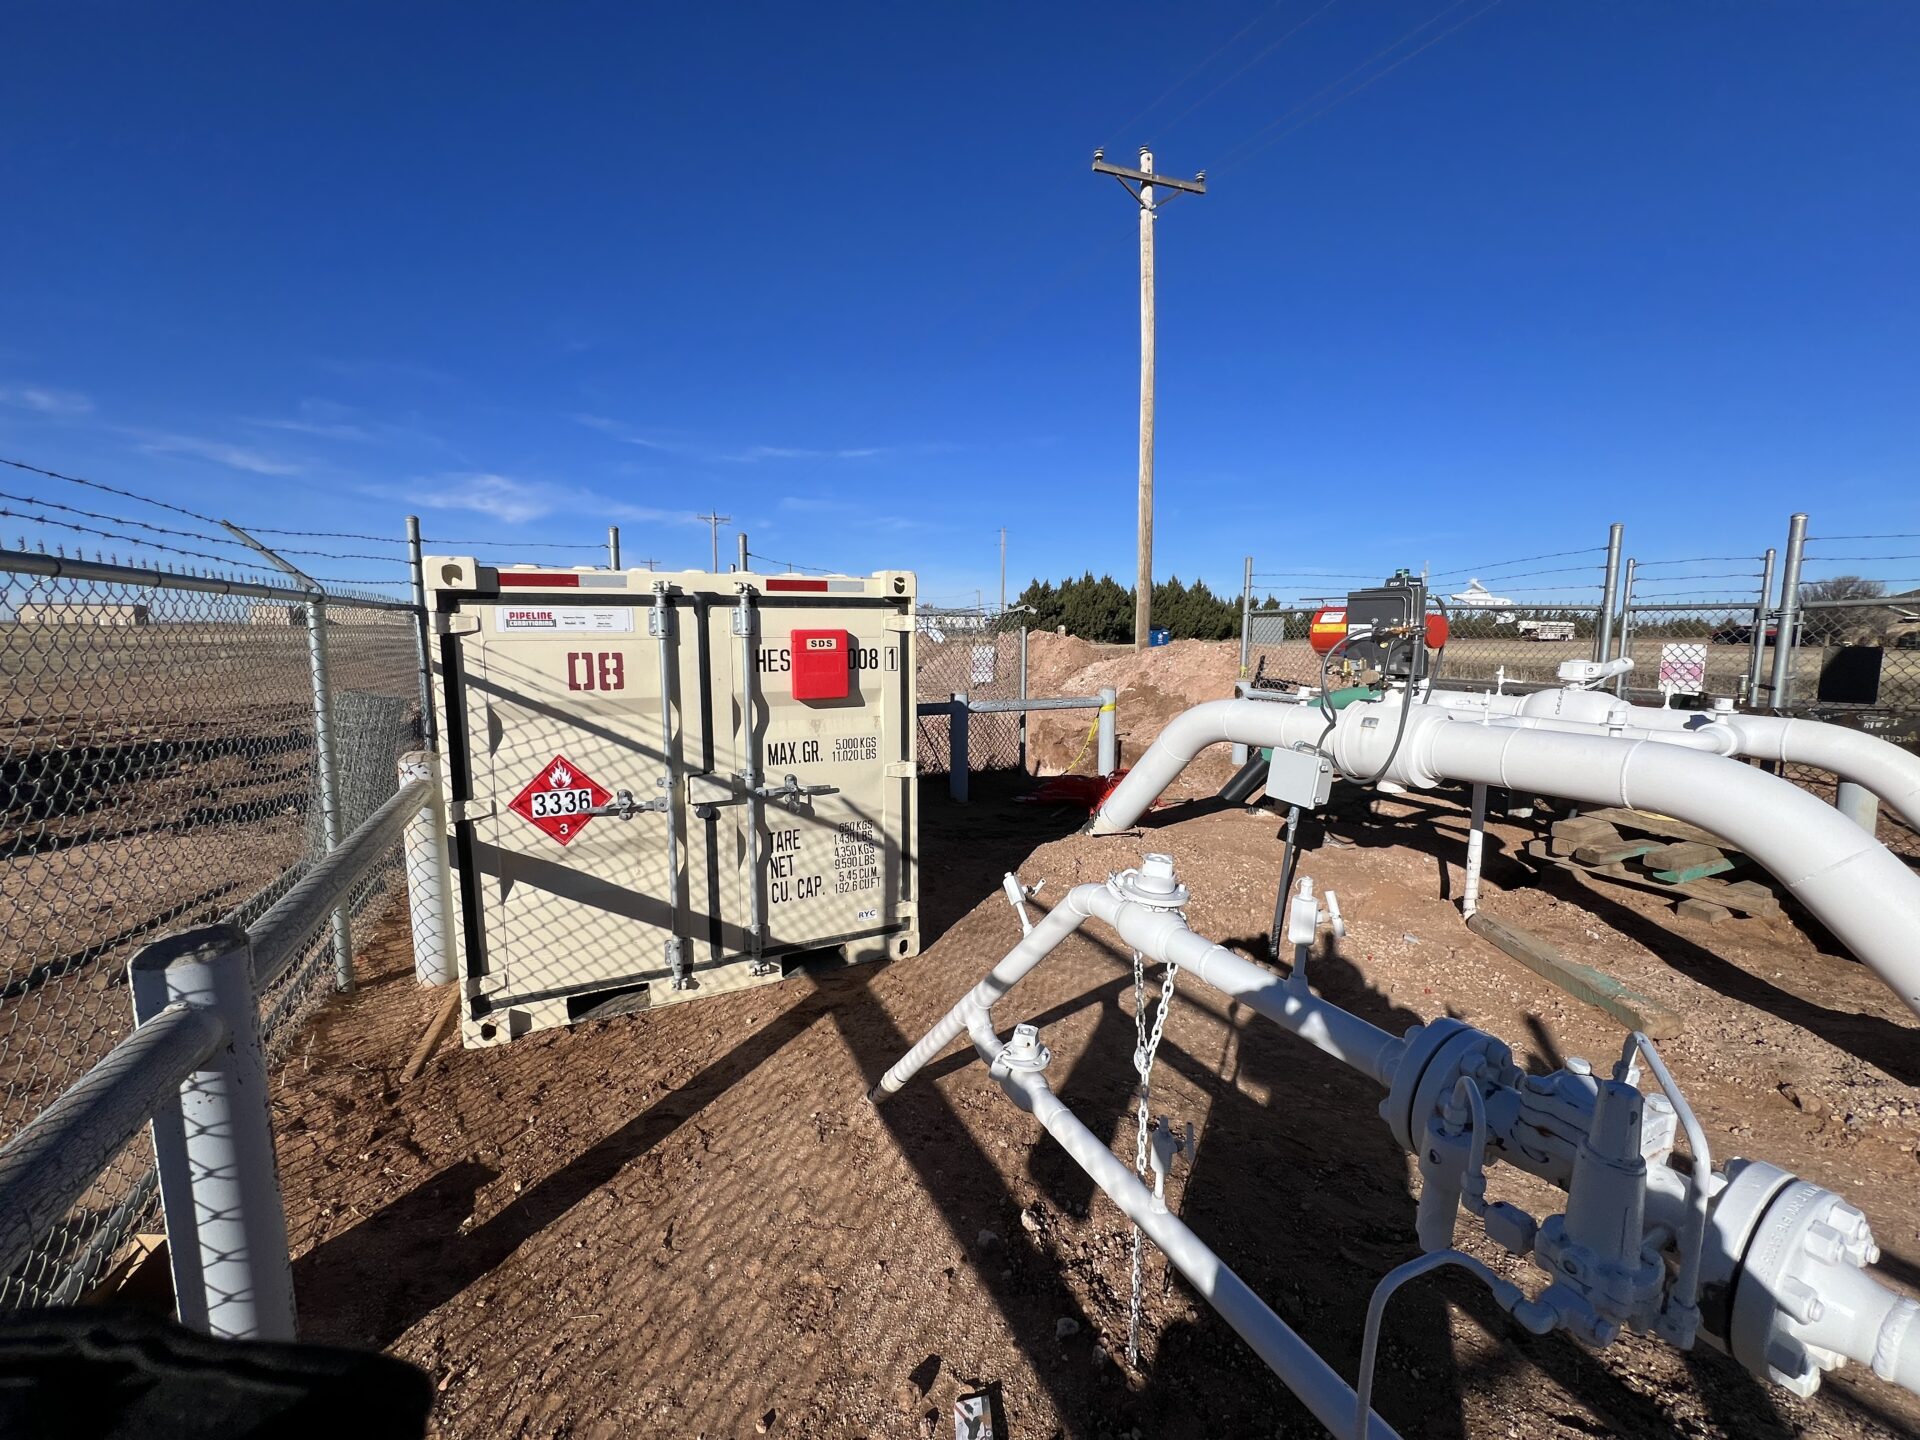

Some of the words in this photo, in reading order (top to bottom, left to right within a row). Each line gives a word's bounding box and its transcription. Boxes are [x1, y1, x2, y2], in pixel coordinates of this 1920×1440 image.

[509, 611, 553, 620] PIPELINE
[810, 639, 833, 648] SDS
[567, 652, 625, 691] 08
[835, 737, 859, 750] 5.000
[860, 736, 877, 749] KGS
[832, 749, 859, 762] 11.020
[860, 748, 877, 760] LBS
[534, 790, 591, 816] 3336
[559, 823, 569, 835] 3
[838, 821, 855, 833] 650
[856, 819, 873, 831] KGS
[768, 829, 801, 853] TARE
[856, 829, 873, 843] LBS
[858, 842, 875, 855] KGS
[769, 854, 794, 880] NET
[859, 854, 876, 867] LBS
[771, 880, 793, 904] CU.
[797, 875, 826, 899] CAP.
[858, 909, 876, 919] RYC
